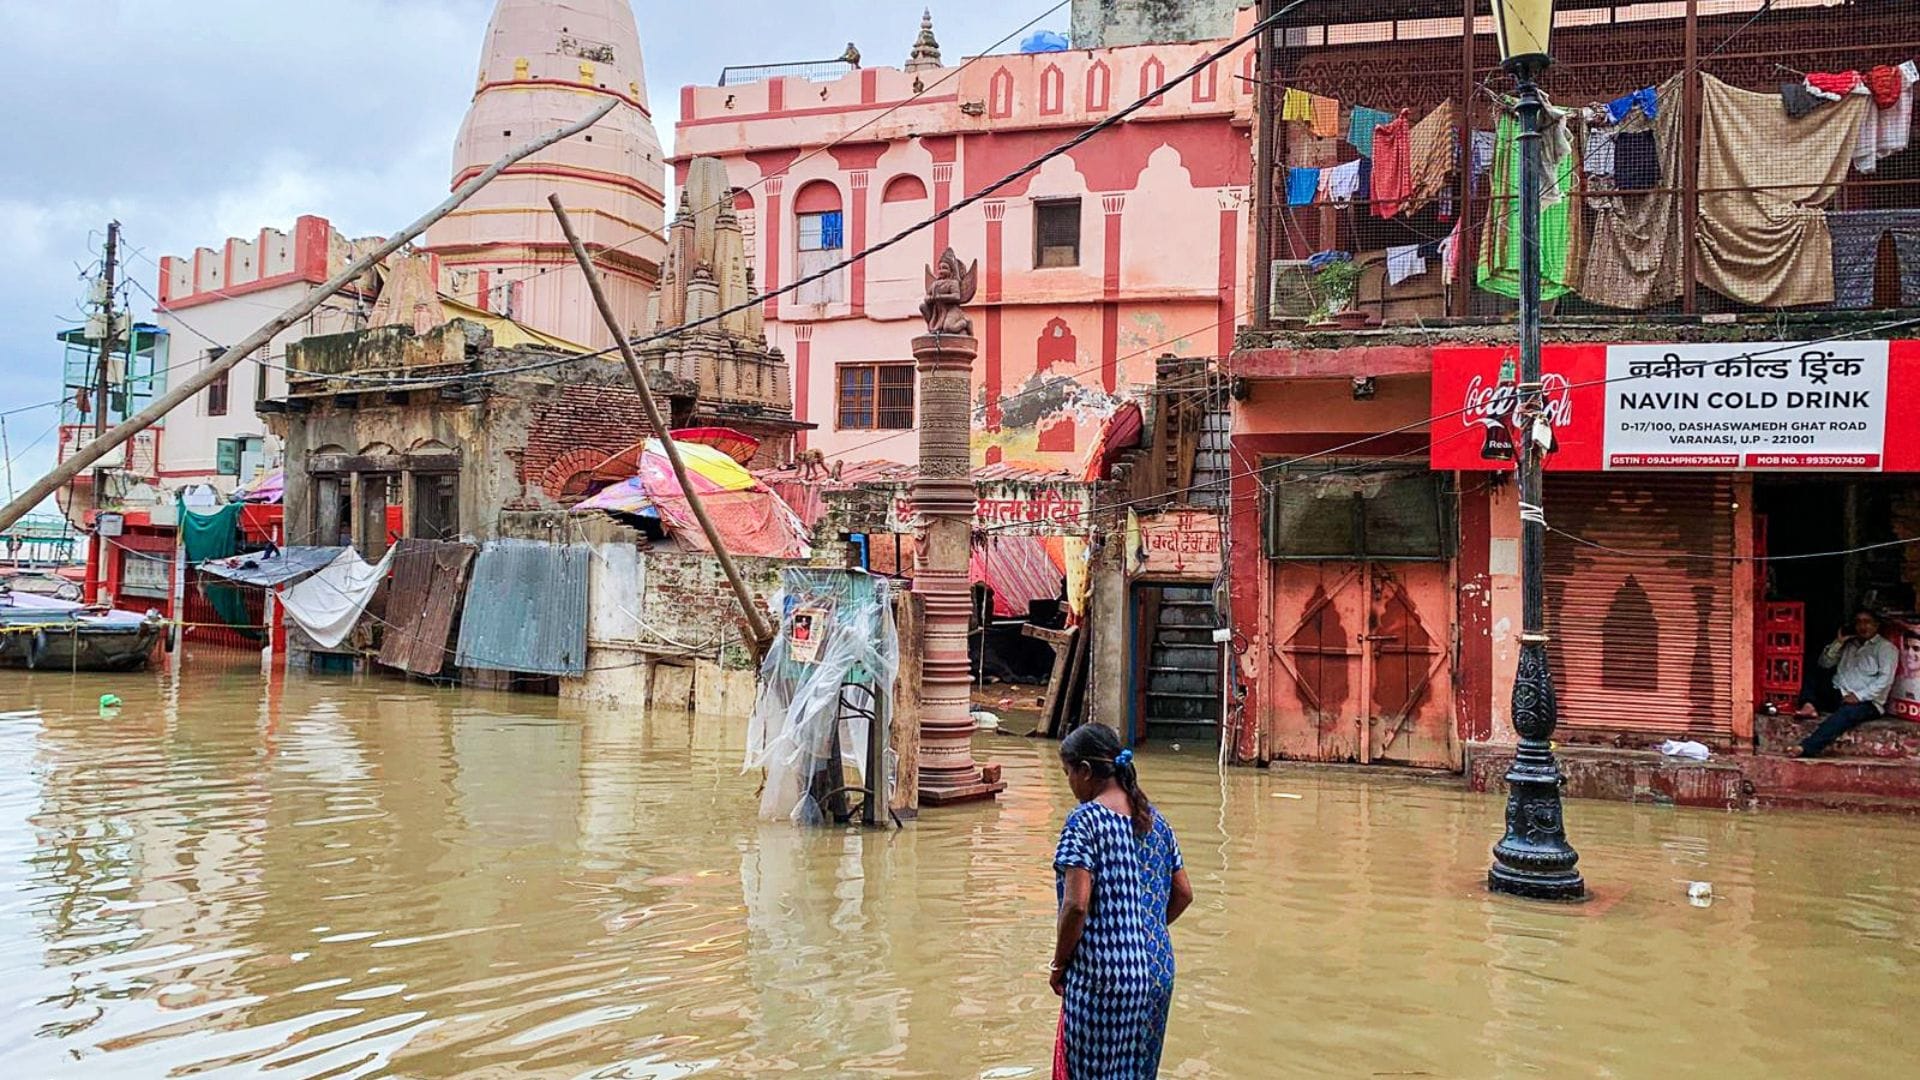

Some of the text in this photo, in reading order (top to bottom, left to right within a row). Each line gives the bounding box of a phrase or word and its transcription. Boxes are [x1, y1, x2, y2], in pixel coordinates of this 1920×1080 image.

[1629, 351, 1865, 385] नवीन कोल्ड ड्रिंक
[1620, 391, 1870, 410] NAVIN COLD DRINK
[1621, 421, 1867, 433] D-17/100, DASHASWAMEDH GHAT ROAD
[1669, 435, 1737, 446] VARANASI,
[1741, 435, 1761, 445] U.P
[1772, 435, 1815, 445] 221001
[1612, 456, 1640, 465] GSTIN
[1757, 456, 1780, 465] MOB
[1781, 456, 1800, 465] NO.
[1806, 456, 1866, 465] 9935707430
